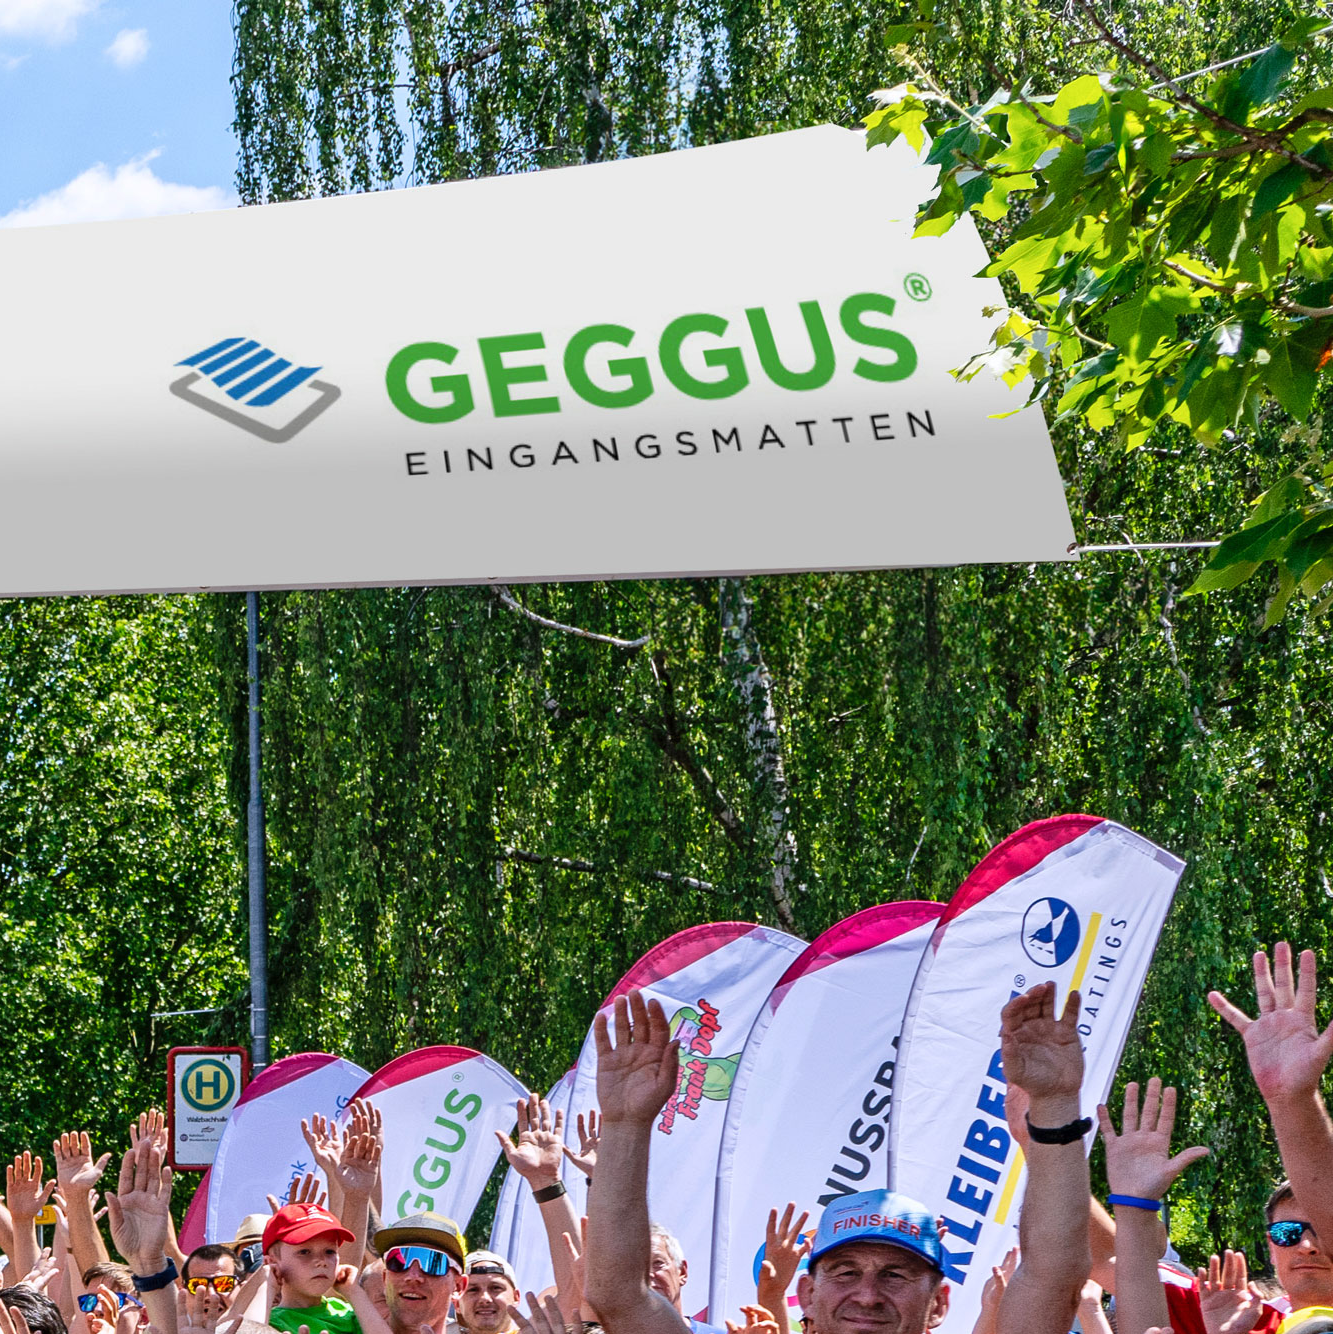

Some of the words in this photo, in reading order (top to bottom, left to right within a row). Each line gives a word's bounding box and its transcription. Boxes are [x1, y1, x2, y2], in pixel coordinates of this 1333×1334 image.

[406, 410, 935, 476] EINGANGSMATTEN
[1078, 917, 1127, 1052] OATINGS
[690, 998, 722, 1056] Dopf
[195, 1071, 220, 1100] H
[677, 1059, 708, 1120] Frank
[833, 1213, 922, 1240] FINISHER
